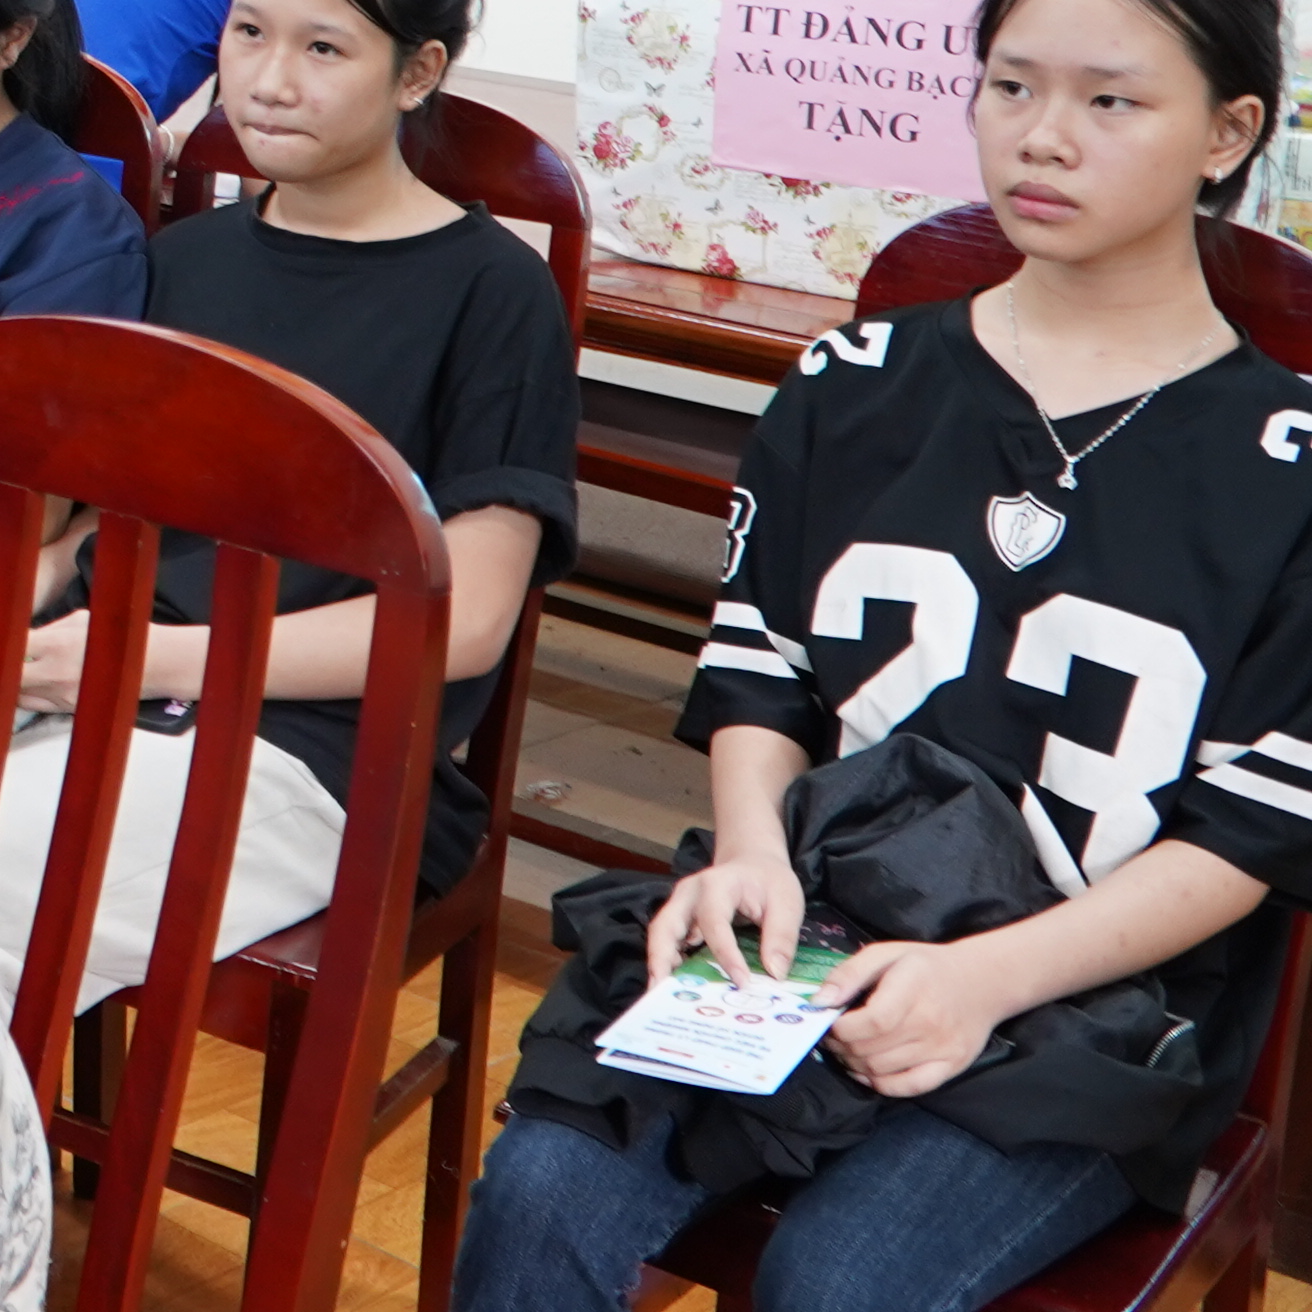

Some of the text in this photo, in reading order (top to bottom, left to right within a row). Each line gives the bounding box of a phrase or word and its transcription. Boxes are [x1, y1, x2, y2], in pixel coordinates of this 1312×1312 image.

[737, 4, 979, 56] TT ĐẢNG U
[734, 49, 980, 101] XÃ QUẢNG BẠC
[799, 100, 921, 144] TẶNG
[811, 542, 1208, 890] 23
